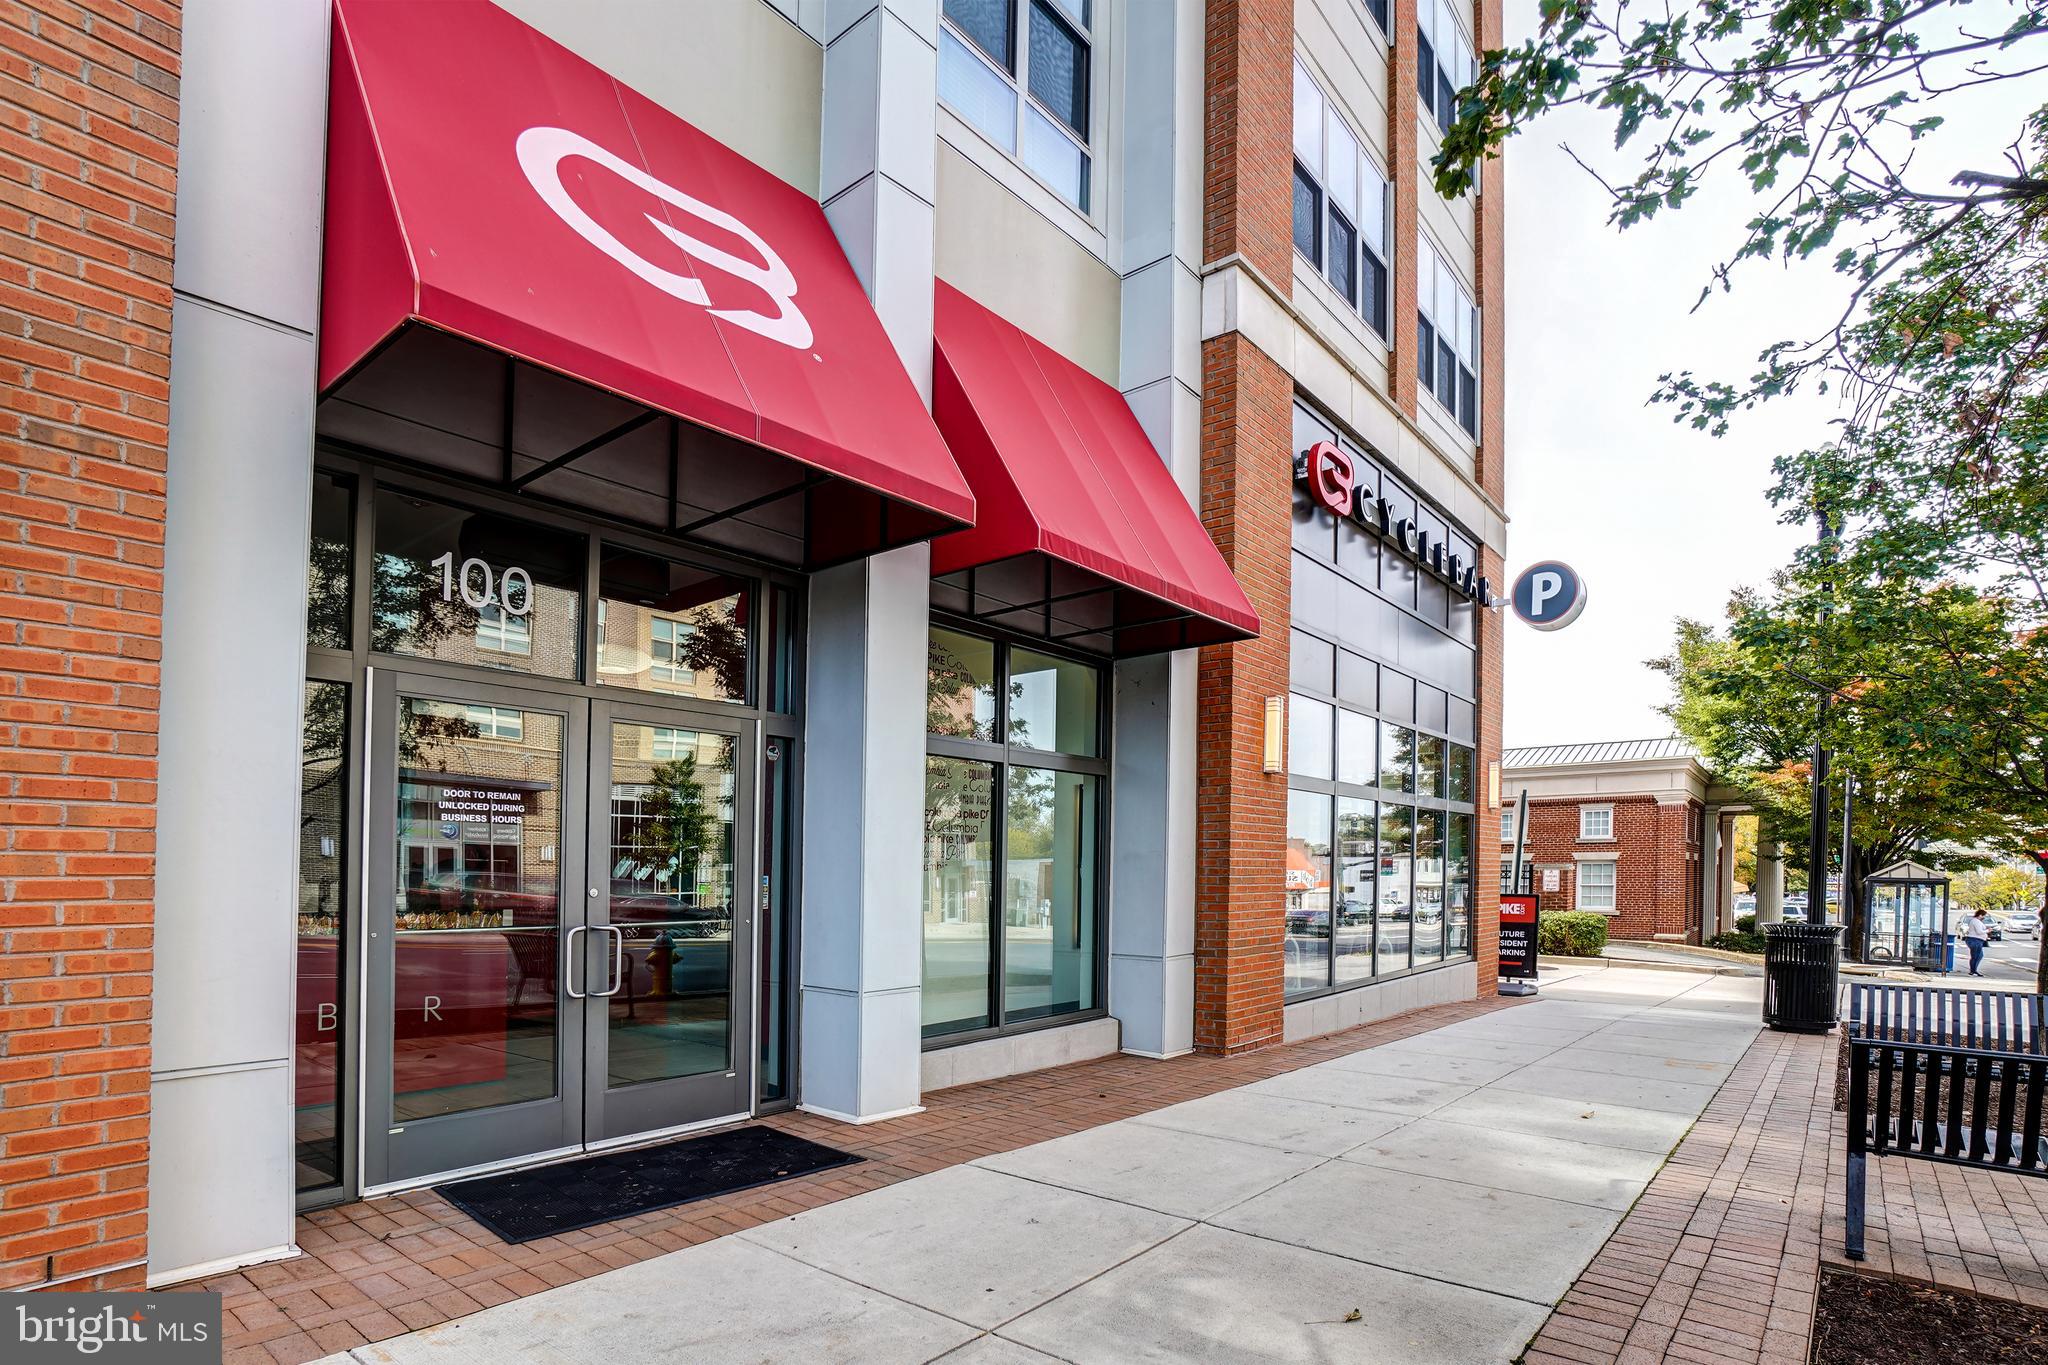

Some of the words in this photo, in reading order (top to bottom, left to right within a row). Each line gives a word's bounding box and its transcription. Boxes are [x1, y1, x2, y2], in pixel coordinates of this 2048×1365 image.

[1352, 483, 1491, 607] CYCLEBAR
[431, 551, 532, 615] 100
[1531, 571, 1562, 616] P
[443, 789, 471, 798] DOOR
[472, 791, 486, 799] TO
[487, 791, 521, 801] REMAIN
[438, 801, 490, 811] UNLOCKED
[491, 803, 525, 813] DURING
[441, 813, 487, 823] BUSINESS
[491, 815, 523, 824] HOURS
[1499, 930, 1525, 938] UTURE
[1499, 949, 1526, 957] ARKING
